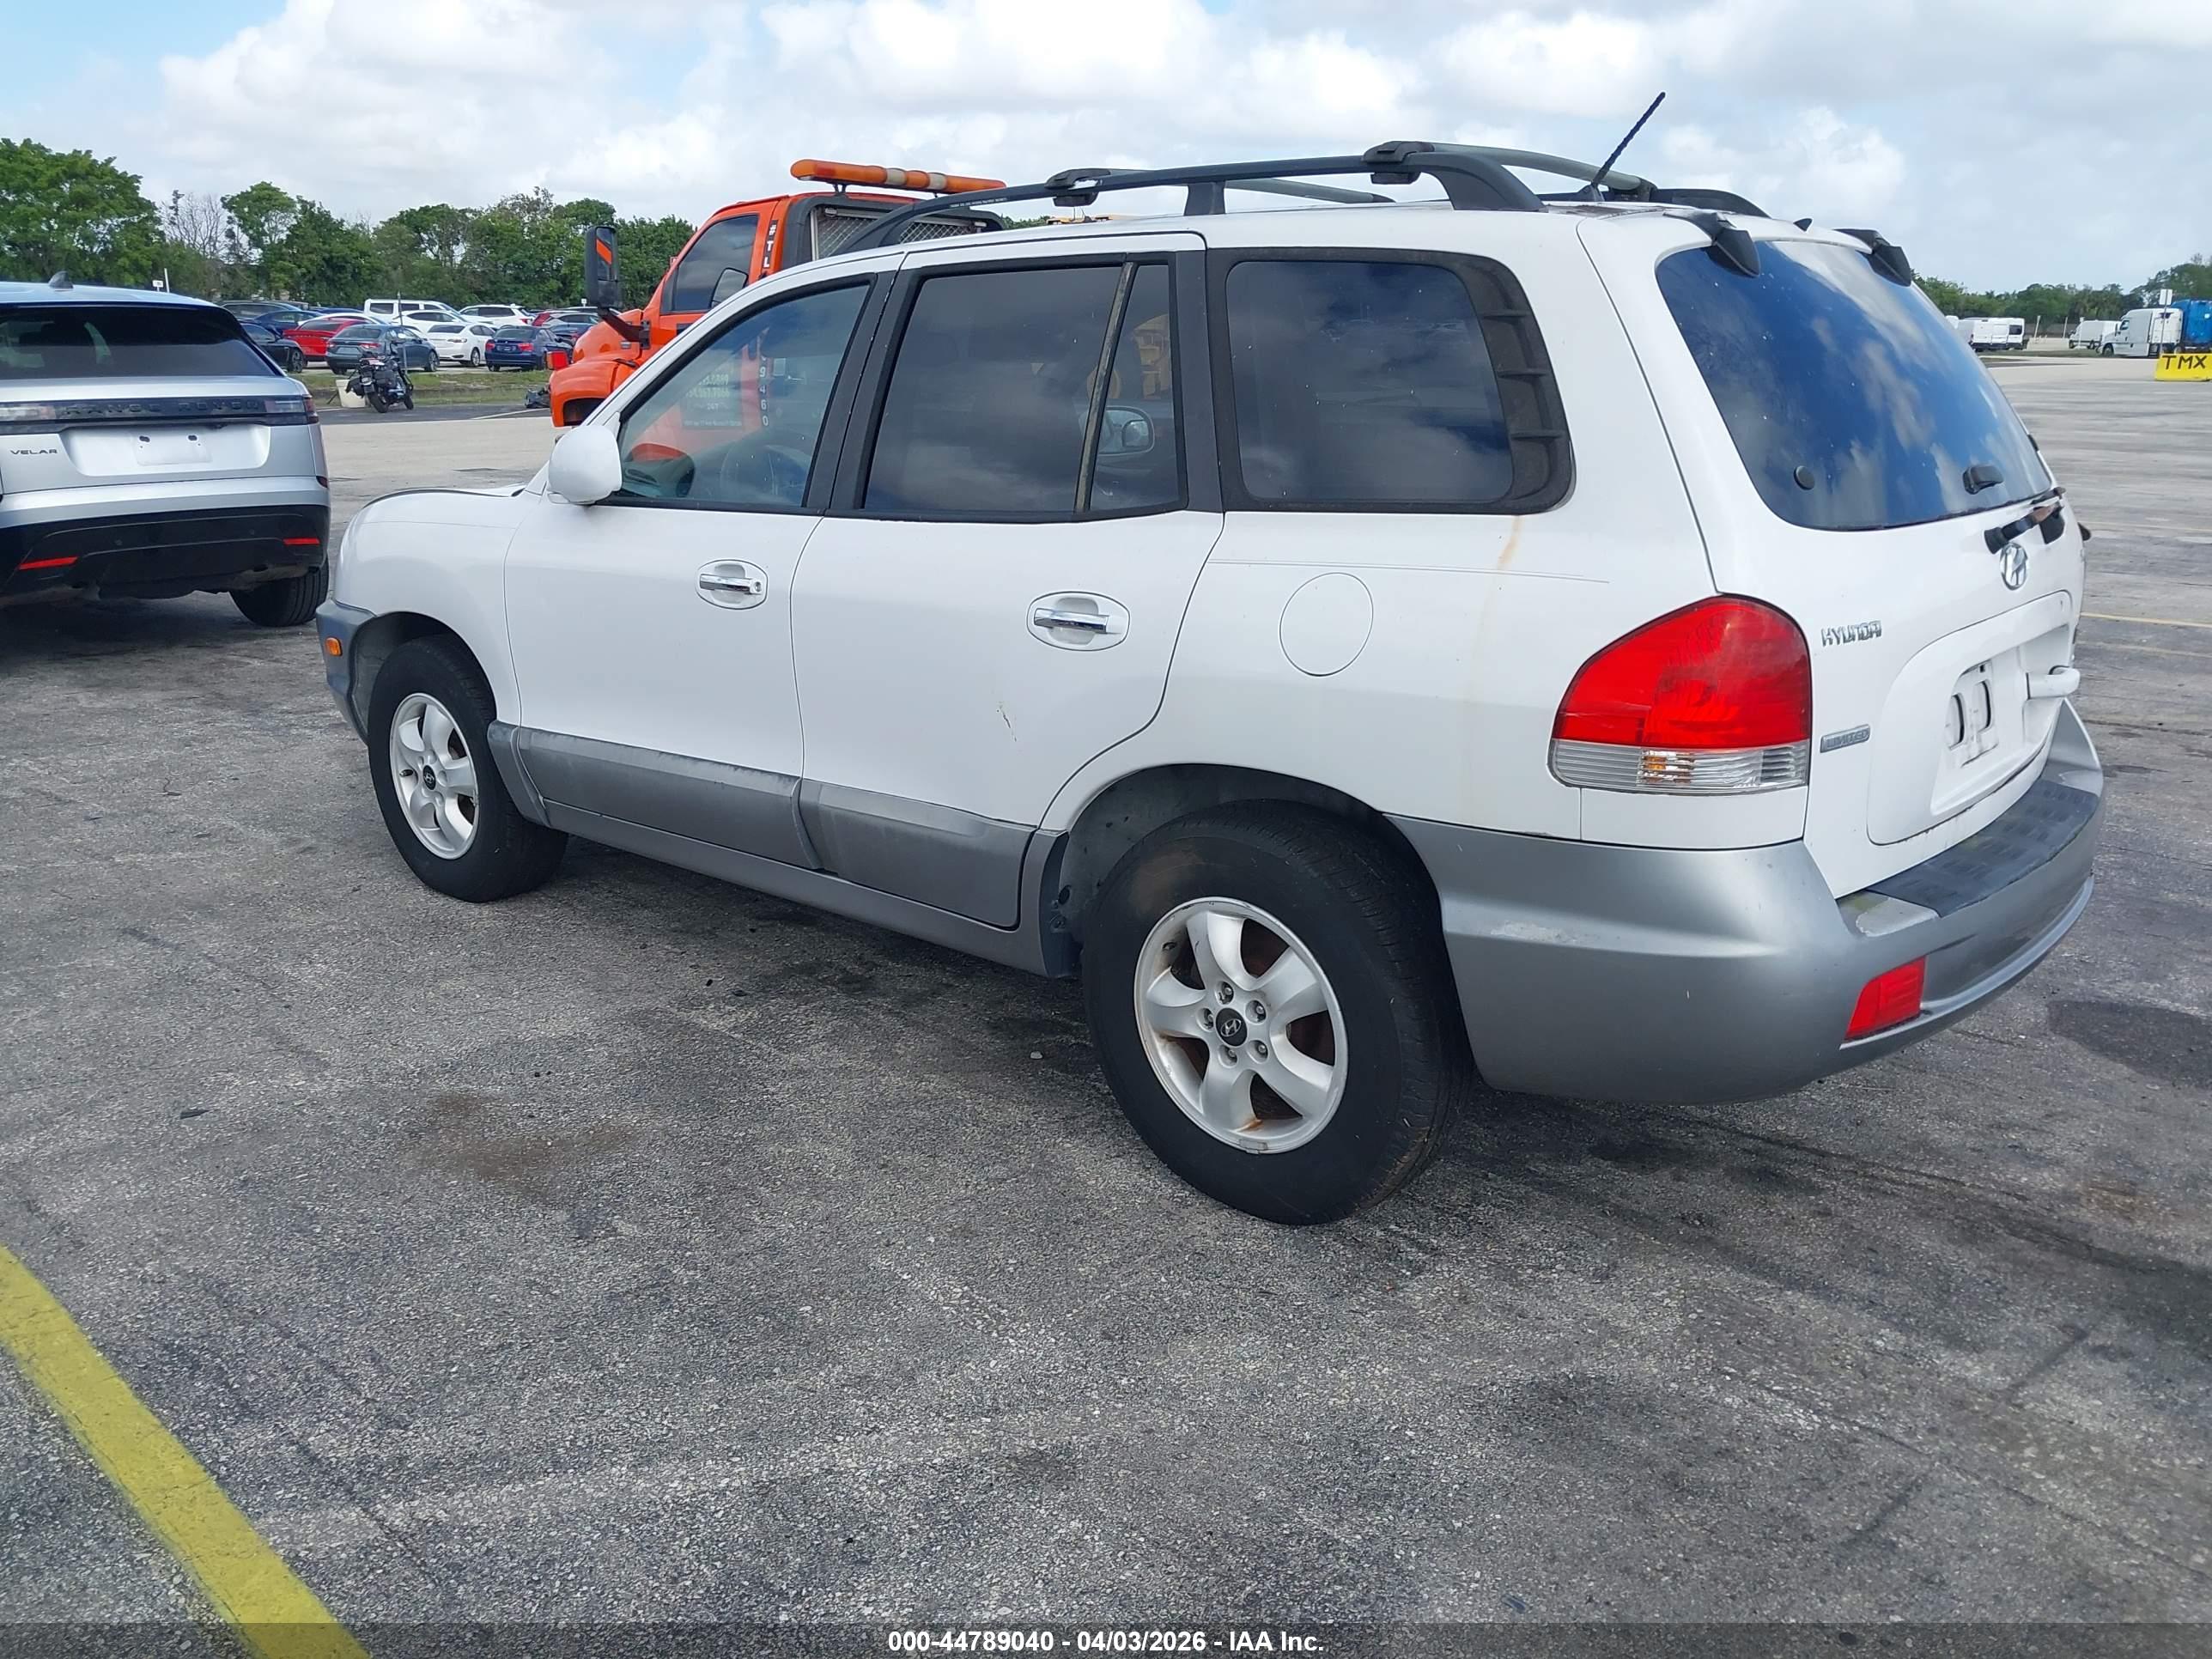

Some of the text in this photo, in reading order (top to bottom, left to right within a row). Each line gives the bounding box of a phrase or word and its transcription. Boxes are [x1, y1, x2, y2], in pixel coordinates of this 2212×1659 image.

[2162, 355, 2207, 370] TMX
[64, 399, 259, 416] RANGE ROVER
[1820, 619, 1882, 647] HYUNDAI
[1825, 728, 1869, 748] LIMITED
